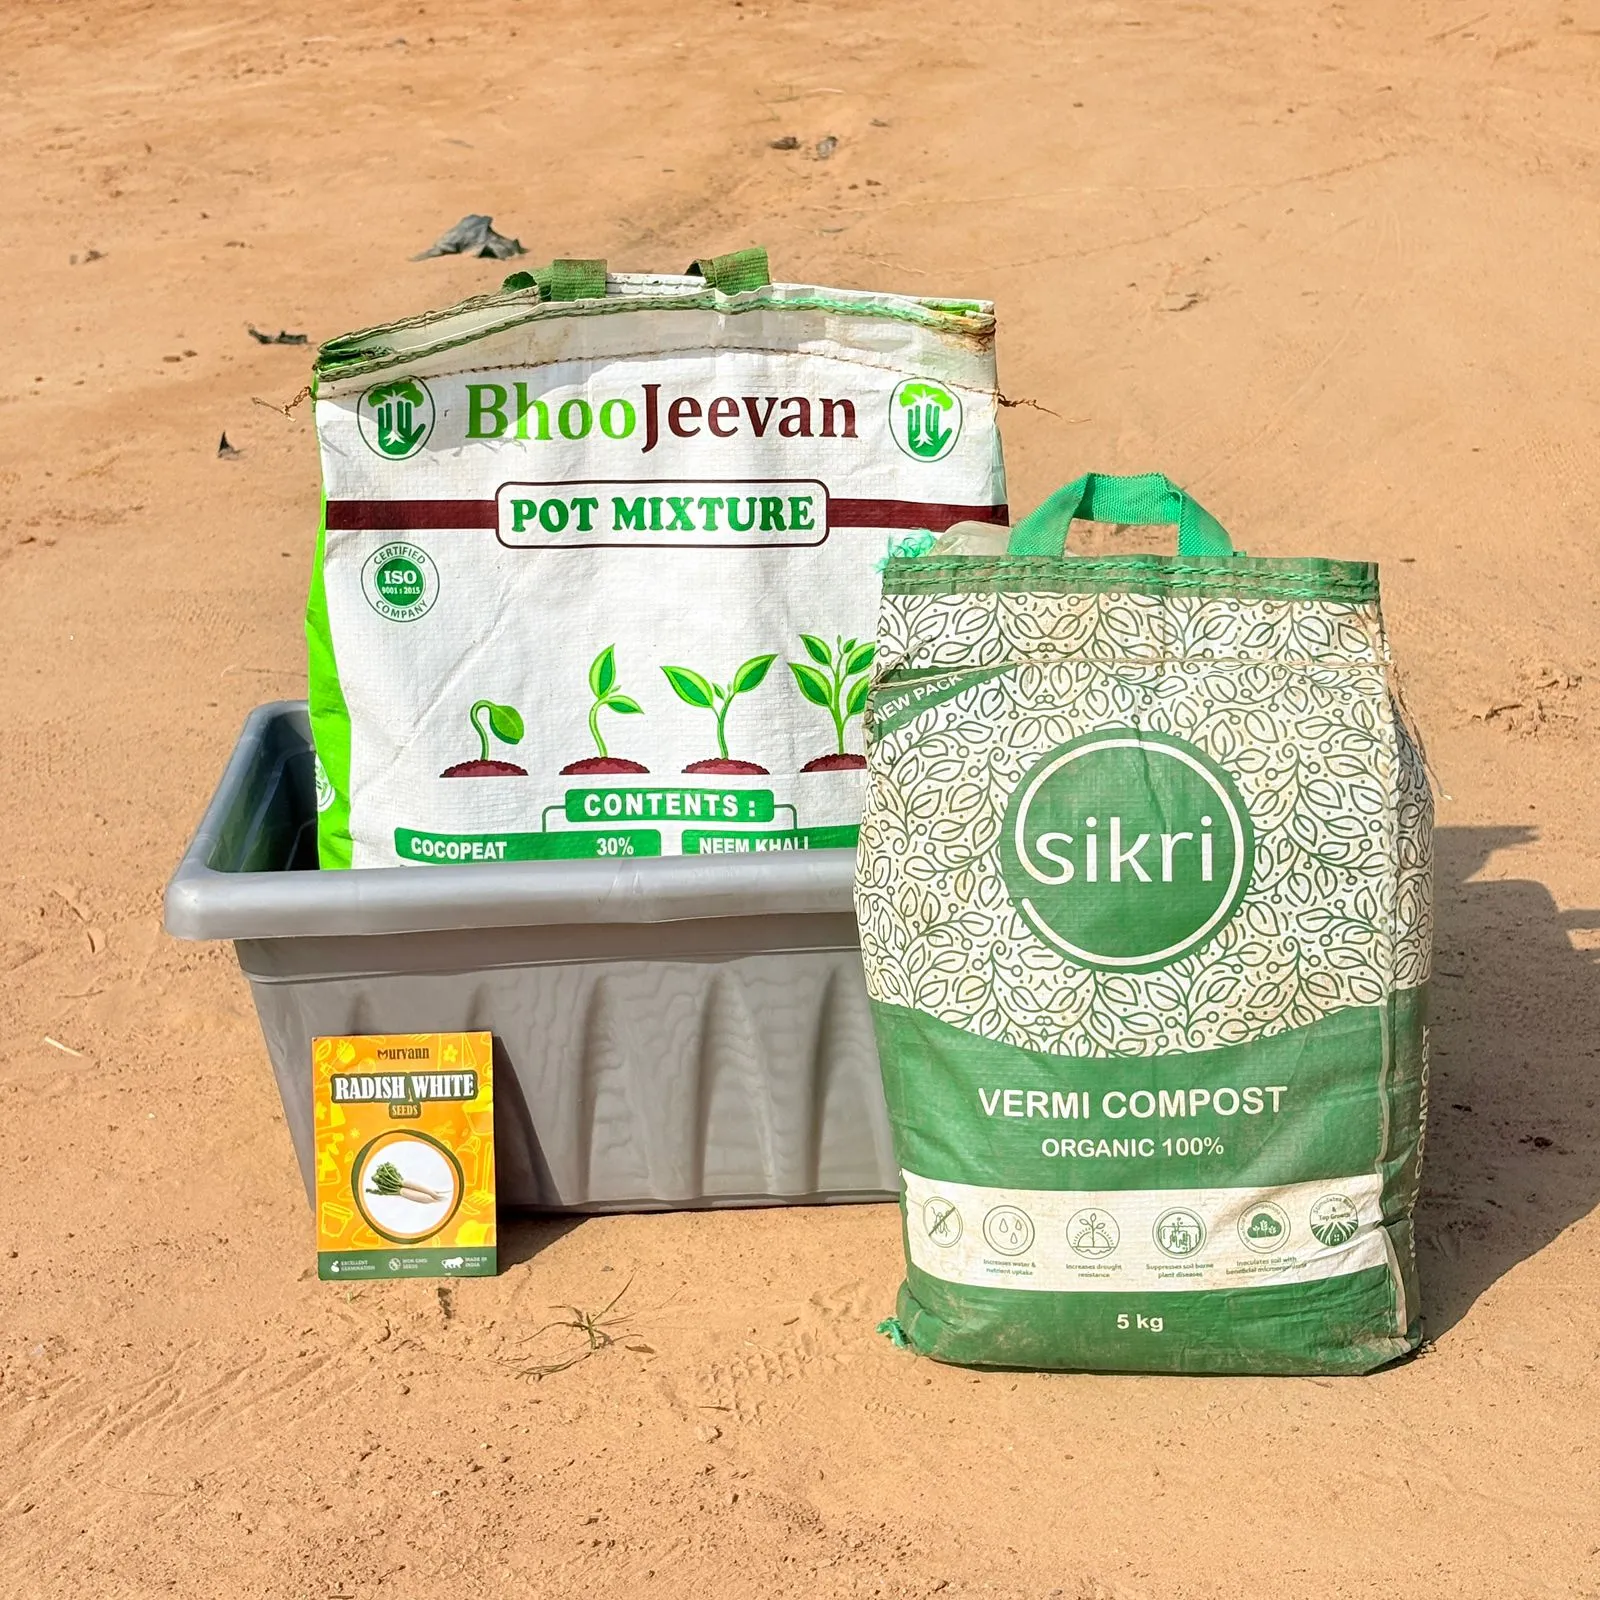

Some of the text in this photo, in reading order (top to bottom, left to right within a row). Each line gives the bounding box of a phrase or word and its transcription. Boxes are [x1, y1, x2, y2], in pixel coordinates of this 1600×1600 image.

[465, 382, 859, 453] BhooJeevan
[510, 495, 816, 533] POT MIXTURE
[373, 545, 426, 565] CERTIFIED
[383, 569, 418, 585] ISO
[381, 586, 399, 595] 9001
[403, 586, 421, 595] 2015
[375, 599, 429, 619] COMPANY
[873, 674, 964, 725] NEW PACK
[583, 793, 739, 817] CONTENTS
[410, 837, 508, 860] COCOPEAT
[596, 836, 635, 857] 30%
[699, 837, 750, 855] NEEM
[1035, 815, 1213, 886] sikri
[334, 1073, 475, 1101] RADISH WHITE
[392, 1104, 419, 1117] SEEDS
[978, 1086, 1288, 1119] VERMI COMPOST
[1041, 1136, 1225, 1158] ORGANIC 100%
[1116, 1313, 1164, 1333] 5 kg
